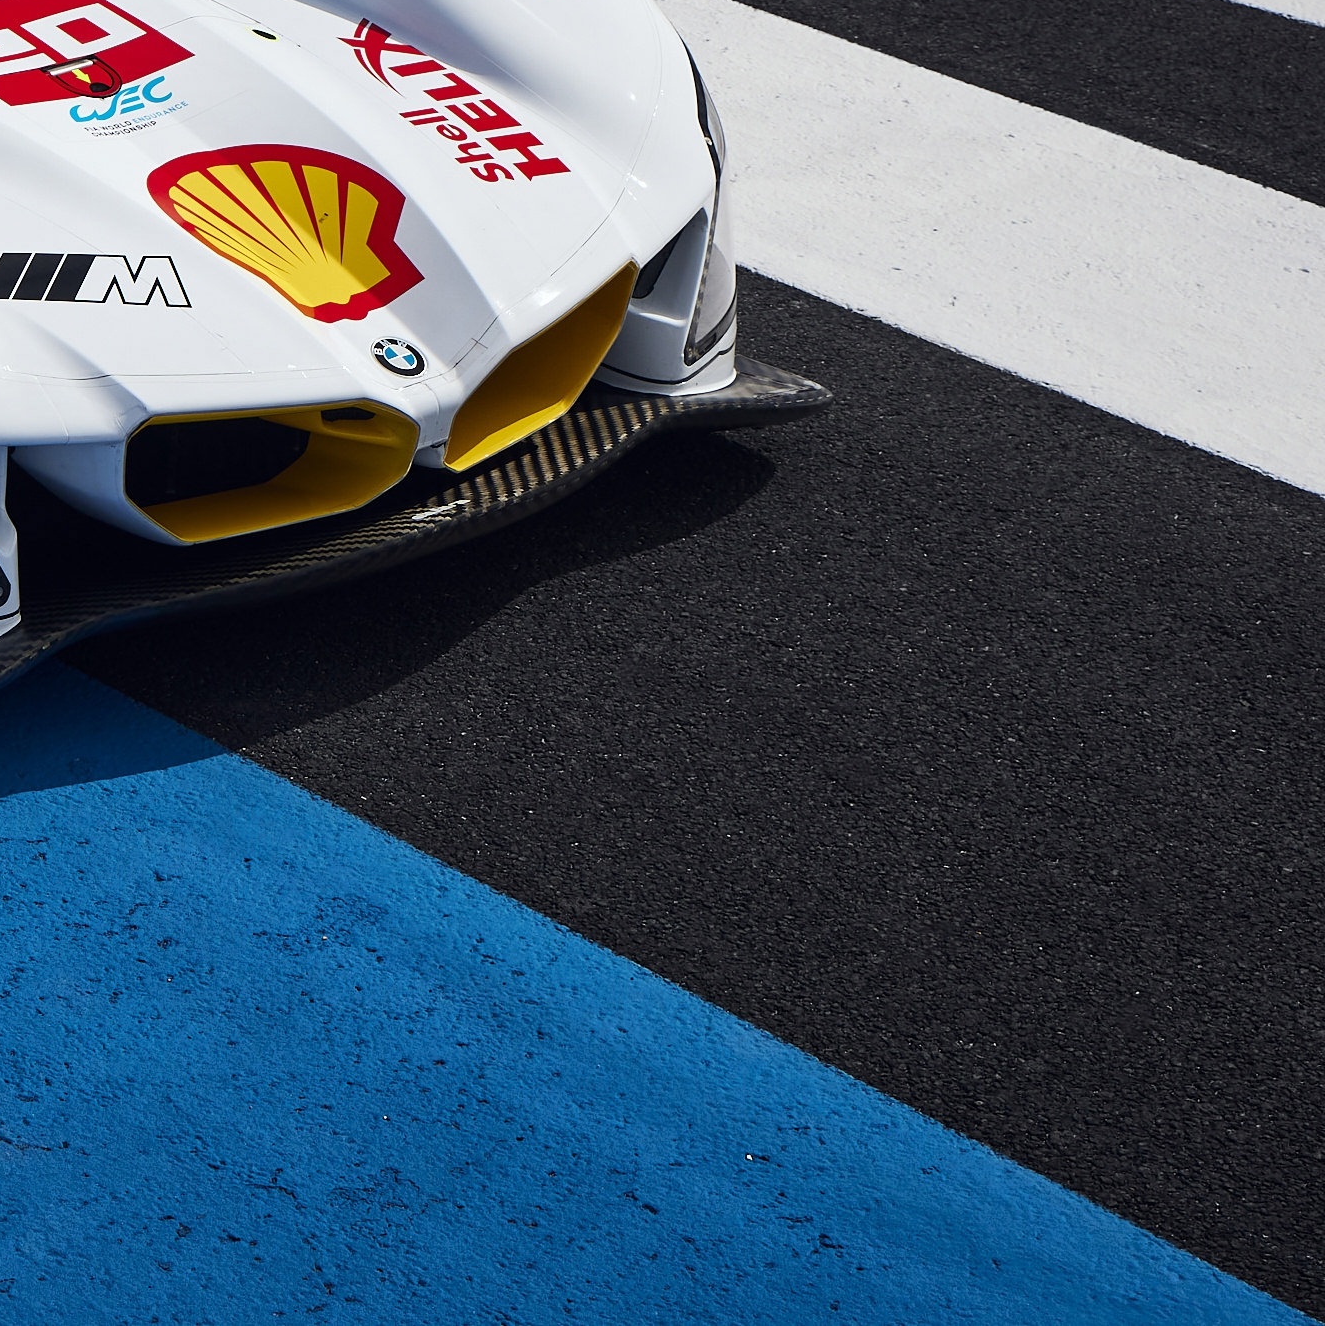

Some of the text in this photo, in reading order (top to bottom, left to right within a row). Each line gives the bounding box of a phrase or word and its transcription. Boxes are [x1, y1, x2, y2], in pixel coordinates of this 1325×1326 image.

[69, 75, 173, 123] WEC
[132, 101, 189, 124] ENDURANCE
[336, 18, 571, 182] HELIX
[399, 107, 515, 184] Shell
